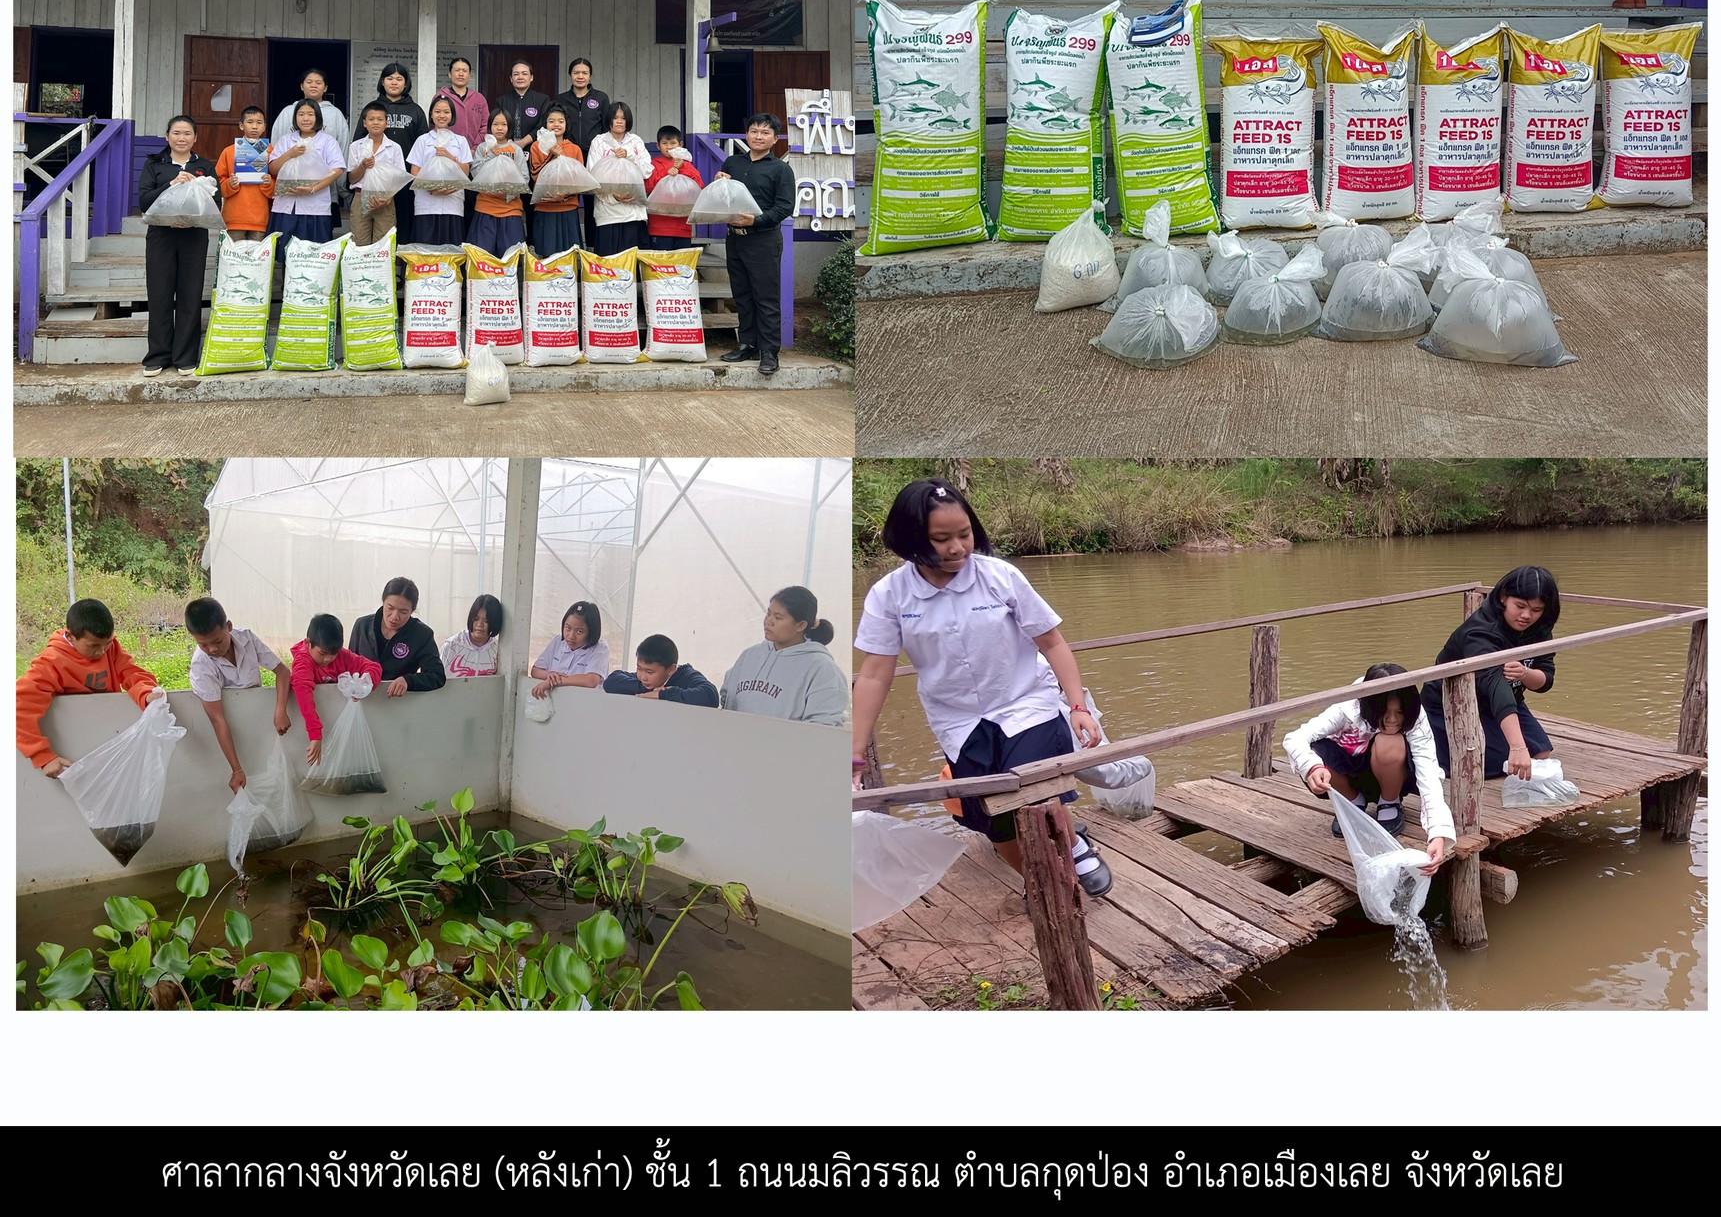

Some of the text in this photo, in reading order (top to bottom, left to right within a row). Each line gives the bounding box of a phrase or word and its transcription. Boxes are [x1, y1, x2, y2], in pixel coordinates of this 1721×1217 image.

[945, 30, 973, 45] 299
[1169, 33, 1191, 47] 299
[1068, 36, 1097, 51] 299
[1623, 109, 1689, 120] ATTRACT
[1233, 120, 1302, 131] ATTRACT
[1346, 115, 1408, 128] ATTRACT
[1439, 117, 1499, 129] ATTRACT
[1526, 116, 1590, 128] ATTRACT
[1623, 122, 1681, 132] FEED 1S
[1233, 133, 1292, 144] FEED 1S
[1346, 129, 1403, 141] FEED 1S
[1439, 130, 1493, 141] FEED 1S
[1526, 130, 1582, 141] FEED 1S
[320, 252, 337, 261] 299
[411, 300, 453, 308] ATTRACT
[480, 299, 518, 307] ATTRACT
[593, 302, 633, 310] ATTRACT
[656, 298, 697, 306] ATTRACT
